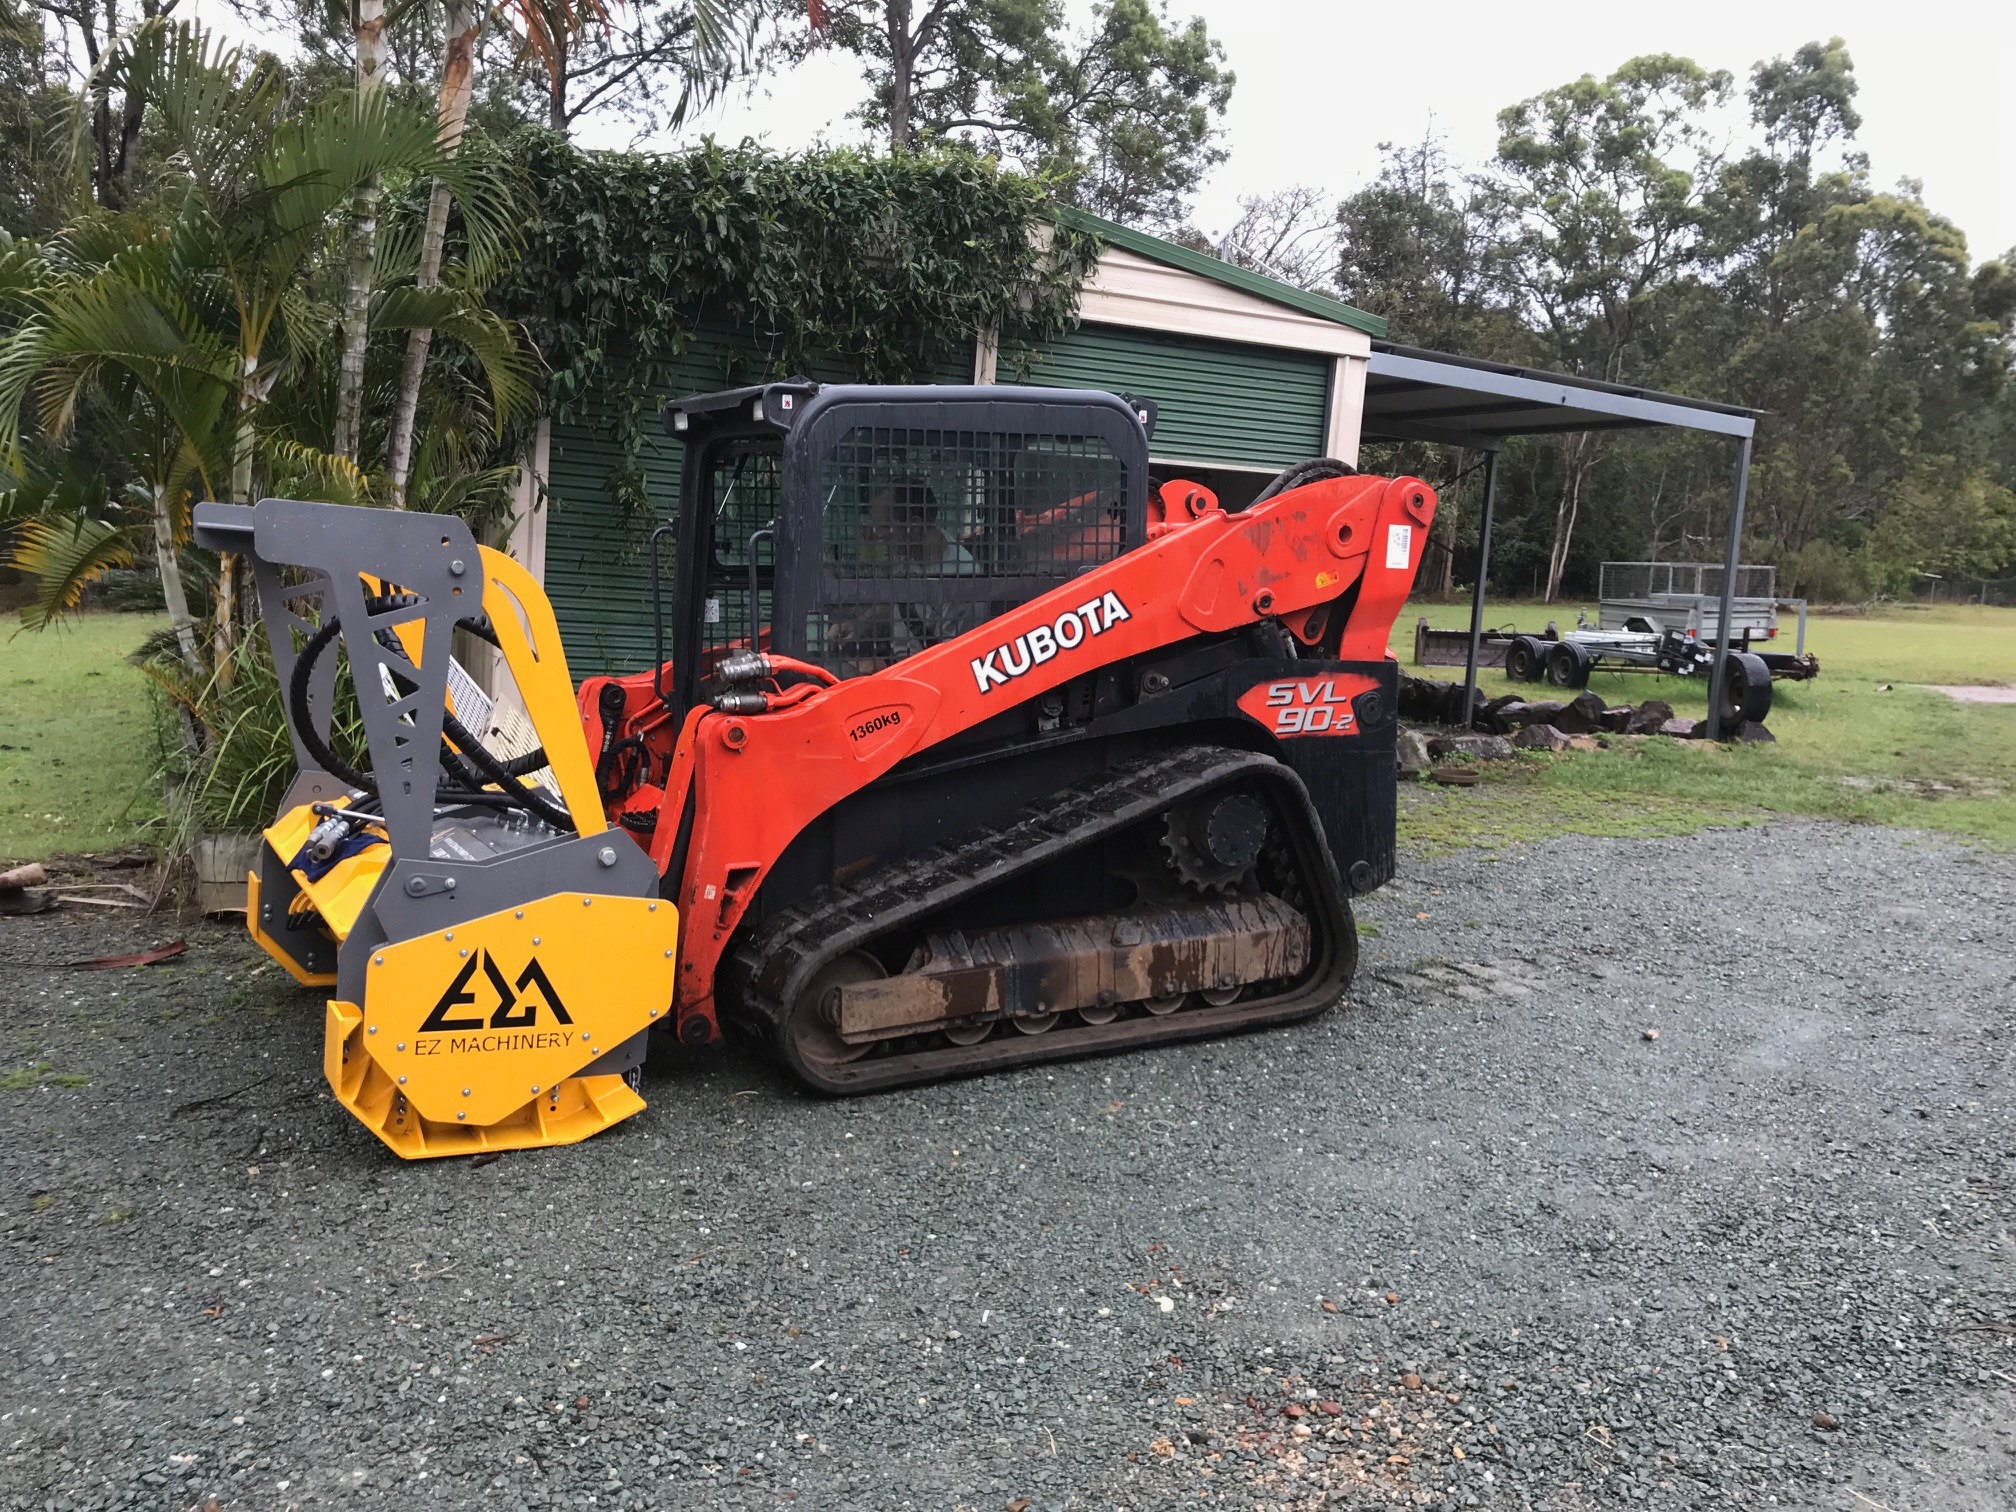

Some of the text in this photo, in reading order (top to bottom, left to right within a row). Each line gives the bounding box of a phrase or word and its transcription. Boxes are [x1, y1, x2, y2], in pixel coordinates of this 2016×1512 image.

[970, 589, 1132, 694] KUBOTA
[1266, 681, 1347, 707] SVL
[850, 711, 901, 742] 1360kg
[414, 1031, 574, 1056] EZ MACHINERY
